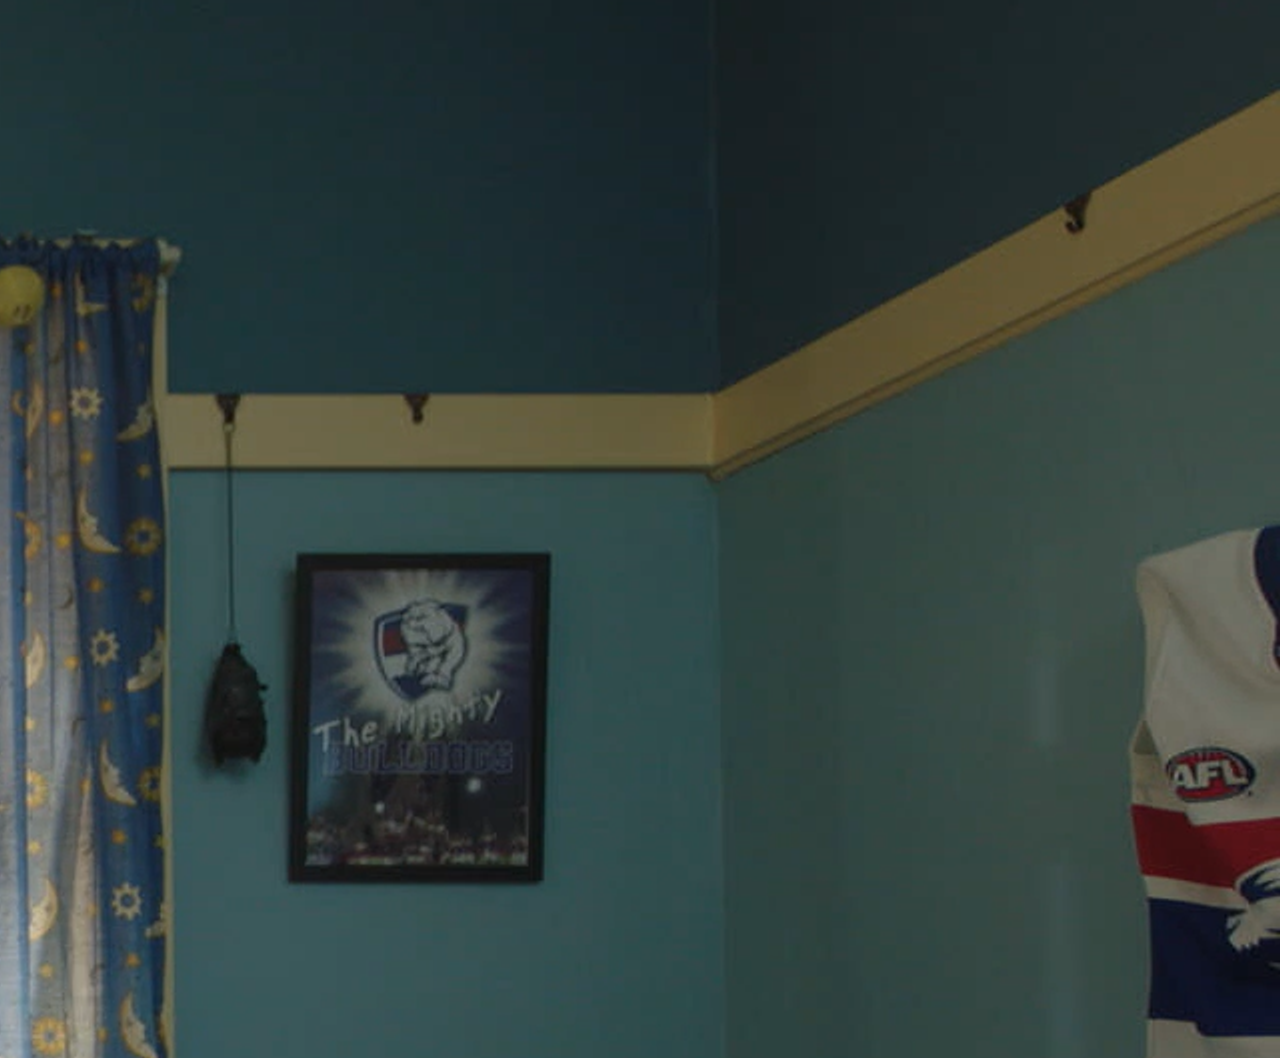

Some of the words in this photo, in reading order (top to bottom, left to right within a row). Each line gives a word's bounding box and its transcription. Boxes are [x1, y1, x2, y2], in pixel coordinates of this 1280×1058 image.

[313, 715, 378, 753] The
[396, 688, 503, 740] Mighty
[1171, 759, 1249, 790] AFL
